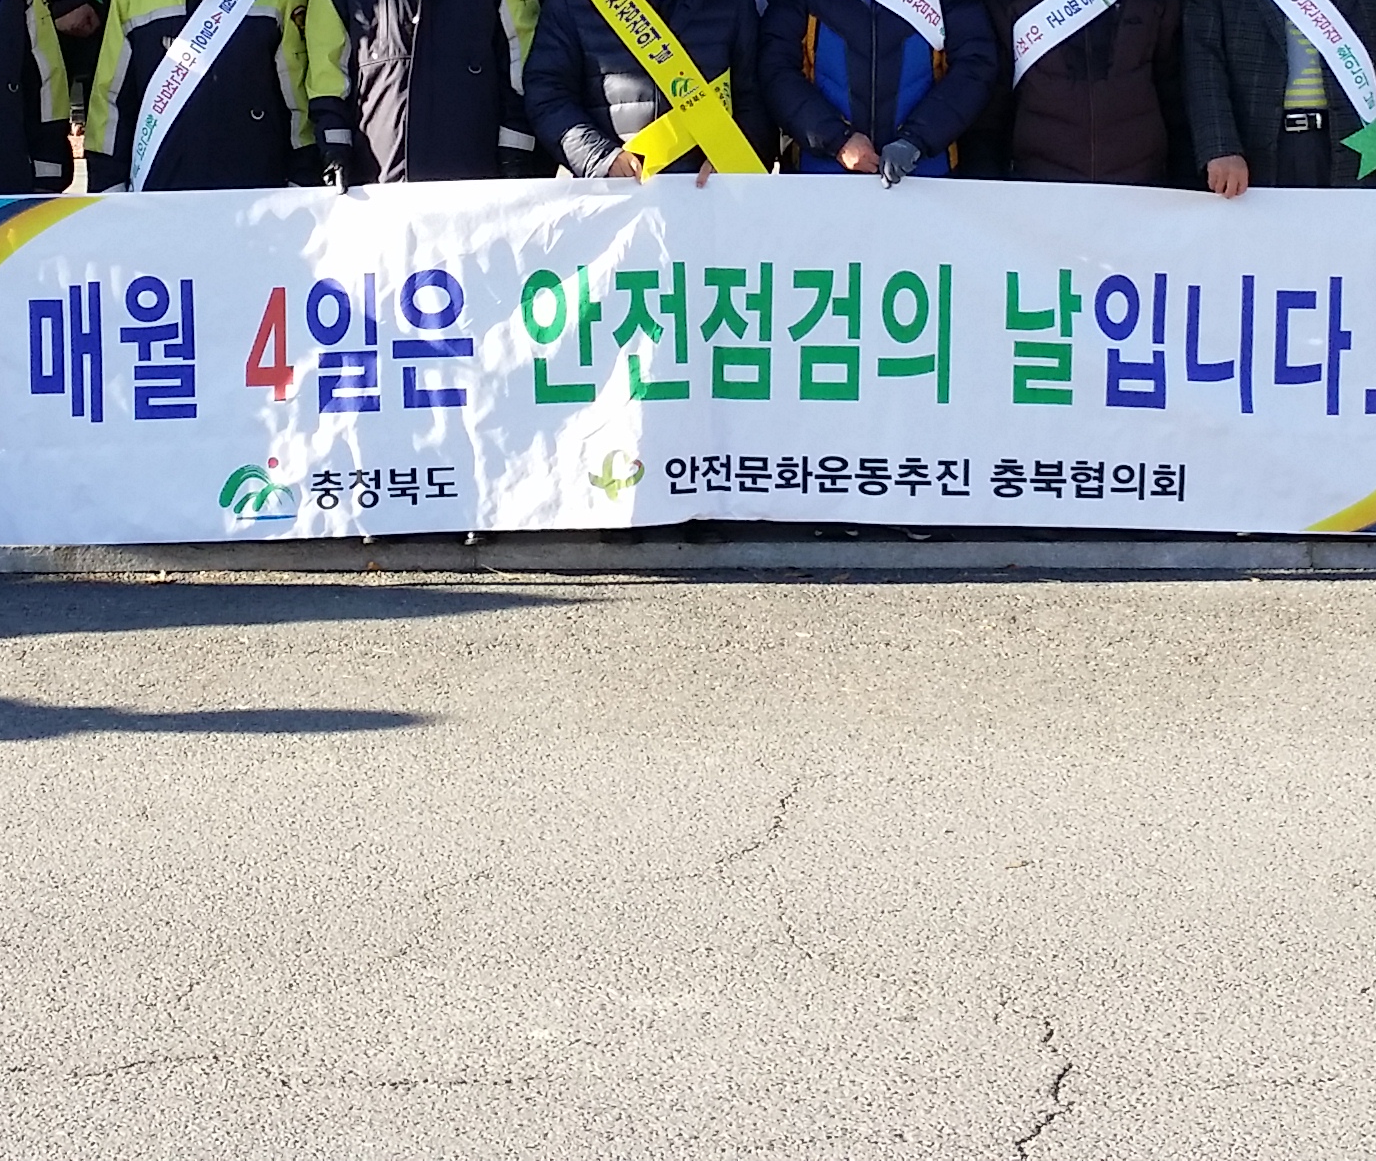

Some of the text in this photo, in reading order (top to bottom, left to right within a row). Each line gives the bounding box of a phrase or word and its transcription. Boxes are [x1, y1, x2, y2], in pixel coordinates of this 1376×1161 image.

[188, 9, 224, 53] 4일은
[648, 41, 676, 67] 날
[150, 52, 196, 114] 안전점검
[29, 275, 197, 423] 매월
[246, 269, 474, 414] 4일은
[520, 261, 952, 405] 안전점검의
[311, 465, 458, 510] 충청북도
[665, 454, 1186, 502] 안전문화운동추진 충북협의회
